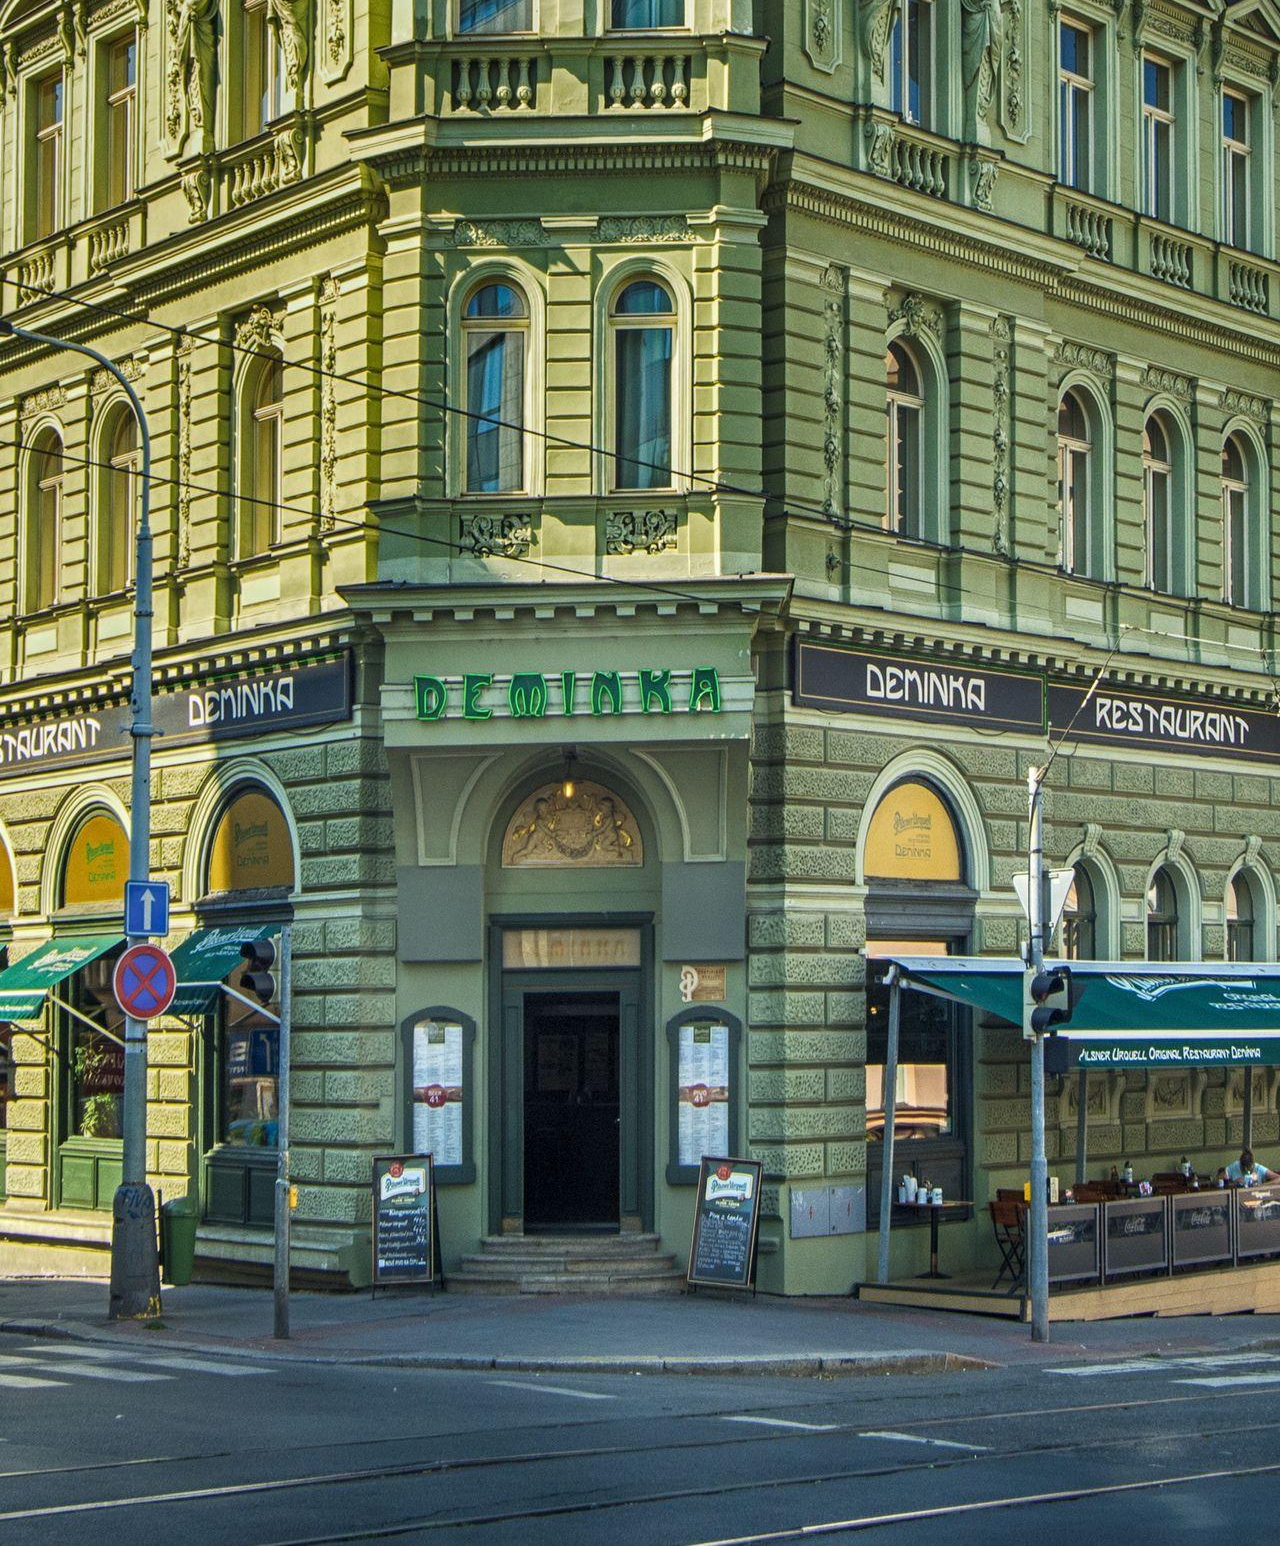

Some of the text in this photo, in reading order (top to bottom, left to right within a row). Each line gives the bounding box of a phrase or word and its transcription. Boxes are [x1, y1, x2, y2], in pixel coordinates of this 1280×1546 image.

[188, 676, 294, 727] DEMINKA
[413, 666, 721, 721] DEMINKA
[866, 663, 986, 711] DEMINKA
[1095, 697, 1250, 744] RESTAURANT
[1112, 1047, 1148, 1061] URQUELL
[1183, 1046, 1230, 1060] RESTAURANT
